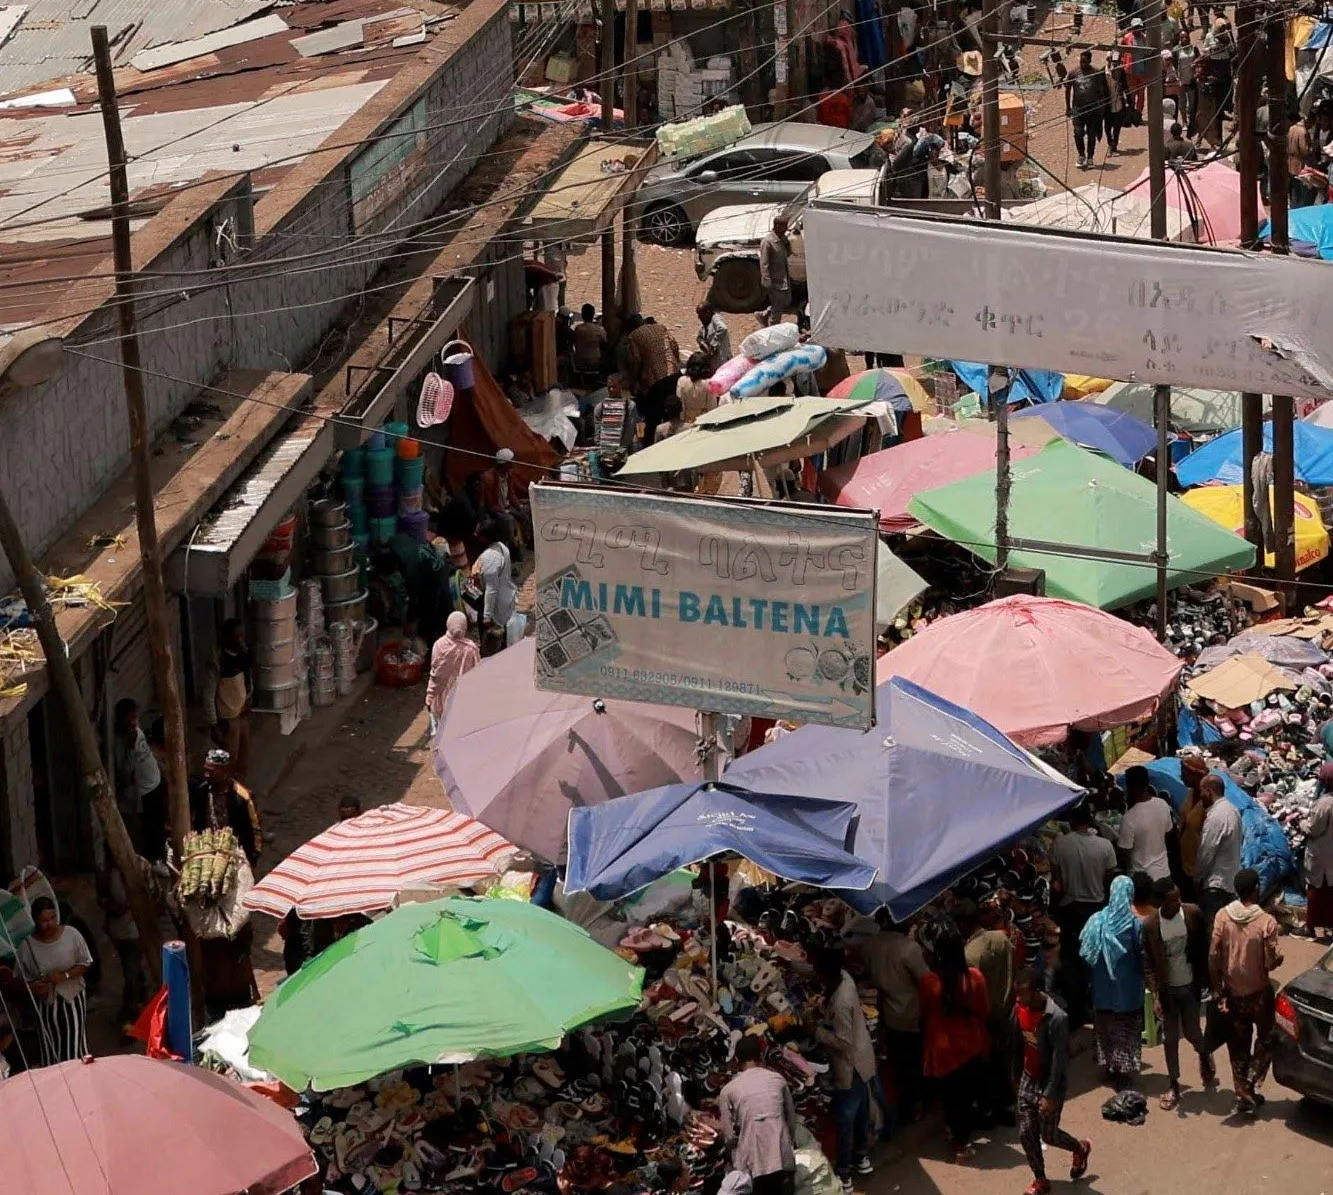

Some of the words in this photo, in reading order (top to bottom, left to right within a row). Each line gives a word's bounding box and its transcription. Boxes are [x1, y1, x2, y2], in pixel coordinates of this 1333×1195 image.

[541, 518, 669, 576] ሚሚ
[700, 531, 865, 591] ባልትና
[559, 576, 661, 619] MIMI
[678, 591, 850, 639] BALTENA
